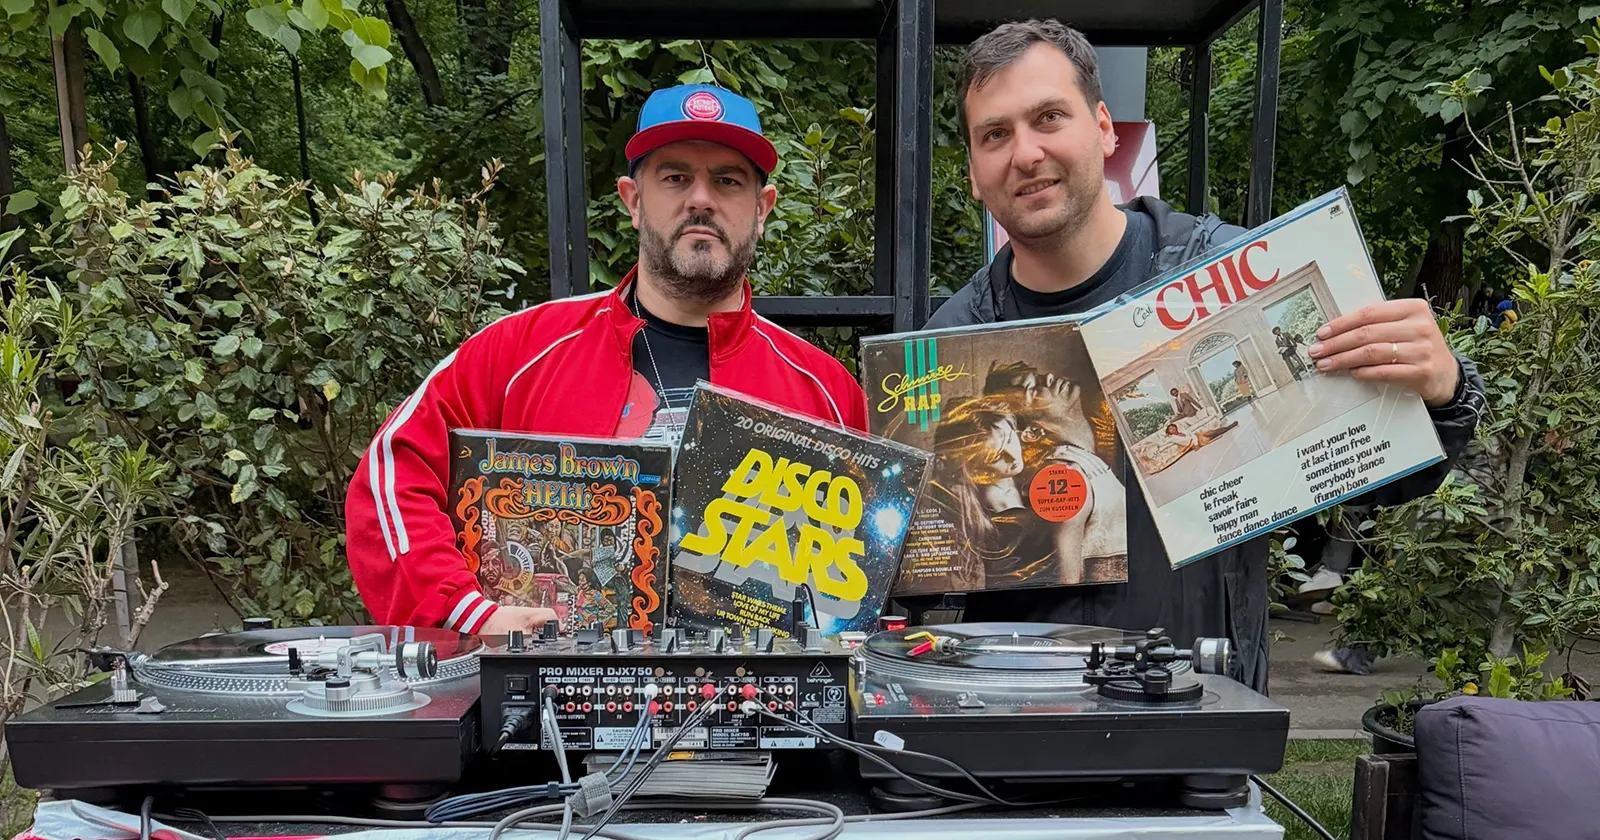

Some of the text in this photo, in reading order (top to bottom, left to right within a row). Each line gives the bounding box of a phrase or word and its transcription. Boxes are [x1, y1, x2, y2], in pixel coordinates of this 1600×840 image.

[1156, 241, 1280, 330] CHIC
[903, 394, 941, 412] RAP
[734, 416, 881, 469] 20 ORIGINAL DISCO HITS
[1296, 423, 1367, 458] i want your love
[1301, 435, 1371, 470] at last i am free
[479, 438, 640, 485] James Brown
[1305, 439, 1391, 482] sometimes you win
[1309, 456, 1385, 493] everybody dance
[522, 479, 593, 511] HELL
[721, 448, 863, 531] DISCO
[1048, 479, 1068, 495] 12
[1199, 476, 1244, 500] chic cheer
[1204, 490, 1238, 512] le freak
[1314, 476, 1369, 505] (funny) bone
[1208, 496, 1258, 523] savoir faire
[1212, 509, 1259, 534] happy man
[1216, 506, 1298, 545] dance dance dance
[679, 498, 868, 602] STARS
[731, 591, 747, 601] STAR
[733, 600, 781, 620] LOVE OF MY LIFE
[716, 609, 726, 617] UP
[726, 612, 746, 624] TOWN
[747, 619, 759, 628] TOP
[740, 609, 770, 624] RUN BACK
[539, 667, 653, 676] PRO MIXER DJX750
